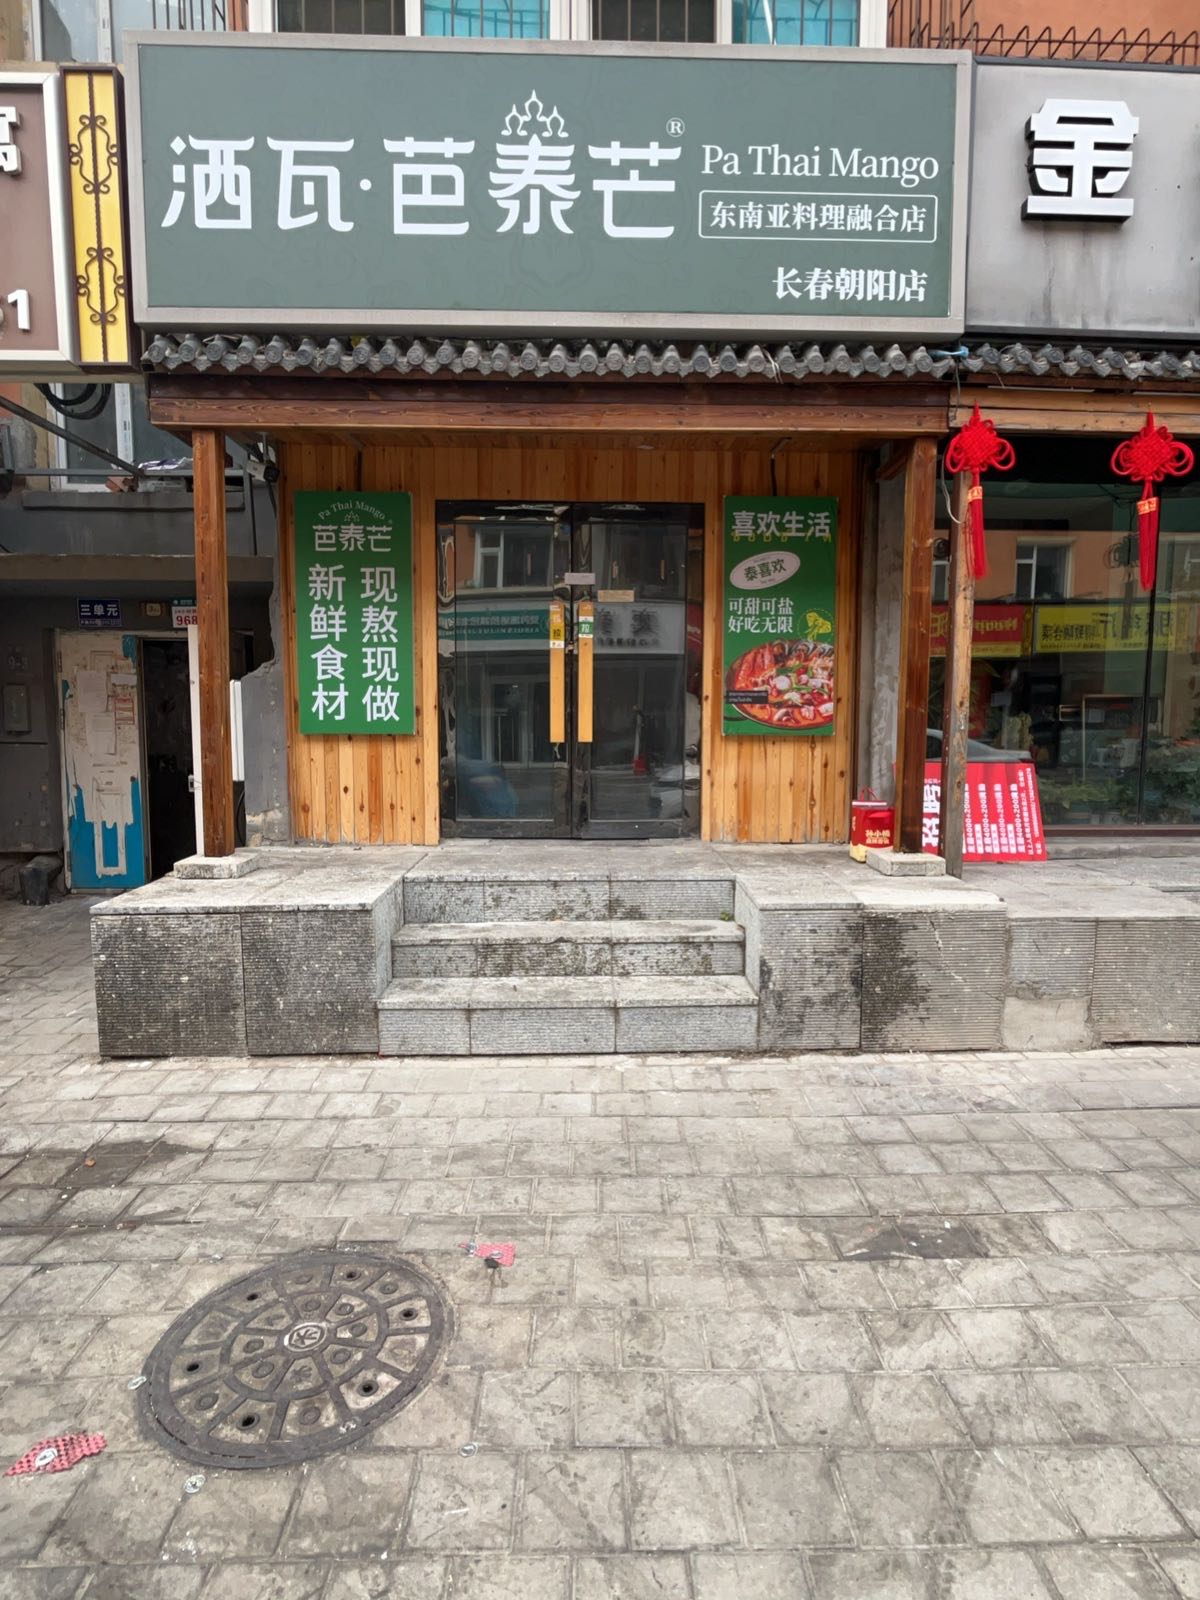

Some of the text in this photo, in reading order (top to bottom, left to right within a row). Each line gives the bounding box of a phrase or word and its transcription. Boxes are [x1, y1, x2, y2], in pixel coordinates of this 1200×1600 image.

[701, 144, 939, 188] Pa Thai Mango
[1024, 98, 1139, 219] 金
[710, 201, 927, 233] 东南亚料理融合店
[772, 266, 929, 302] 长春朝阳店
[318, 500, 386, 520] Pa Thai Mango
[732, 510, 831, 537] 喜欢生活
[312, 522, 393, 552] 芭泰芒
[744, 559, 787, 581] 泰喜欢
[80, 604, 118, 616] 三单元
[728, 597, 794, 615] 可甜可盐
[728, 616, 794, 633] 好吃无限
[308, 563, 349, 721] 新鲜食材
[360, 567, 400, 722] 现熬现做
